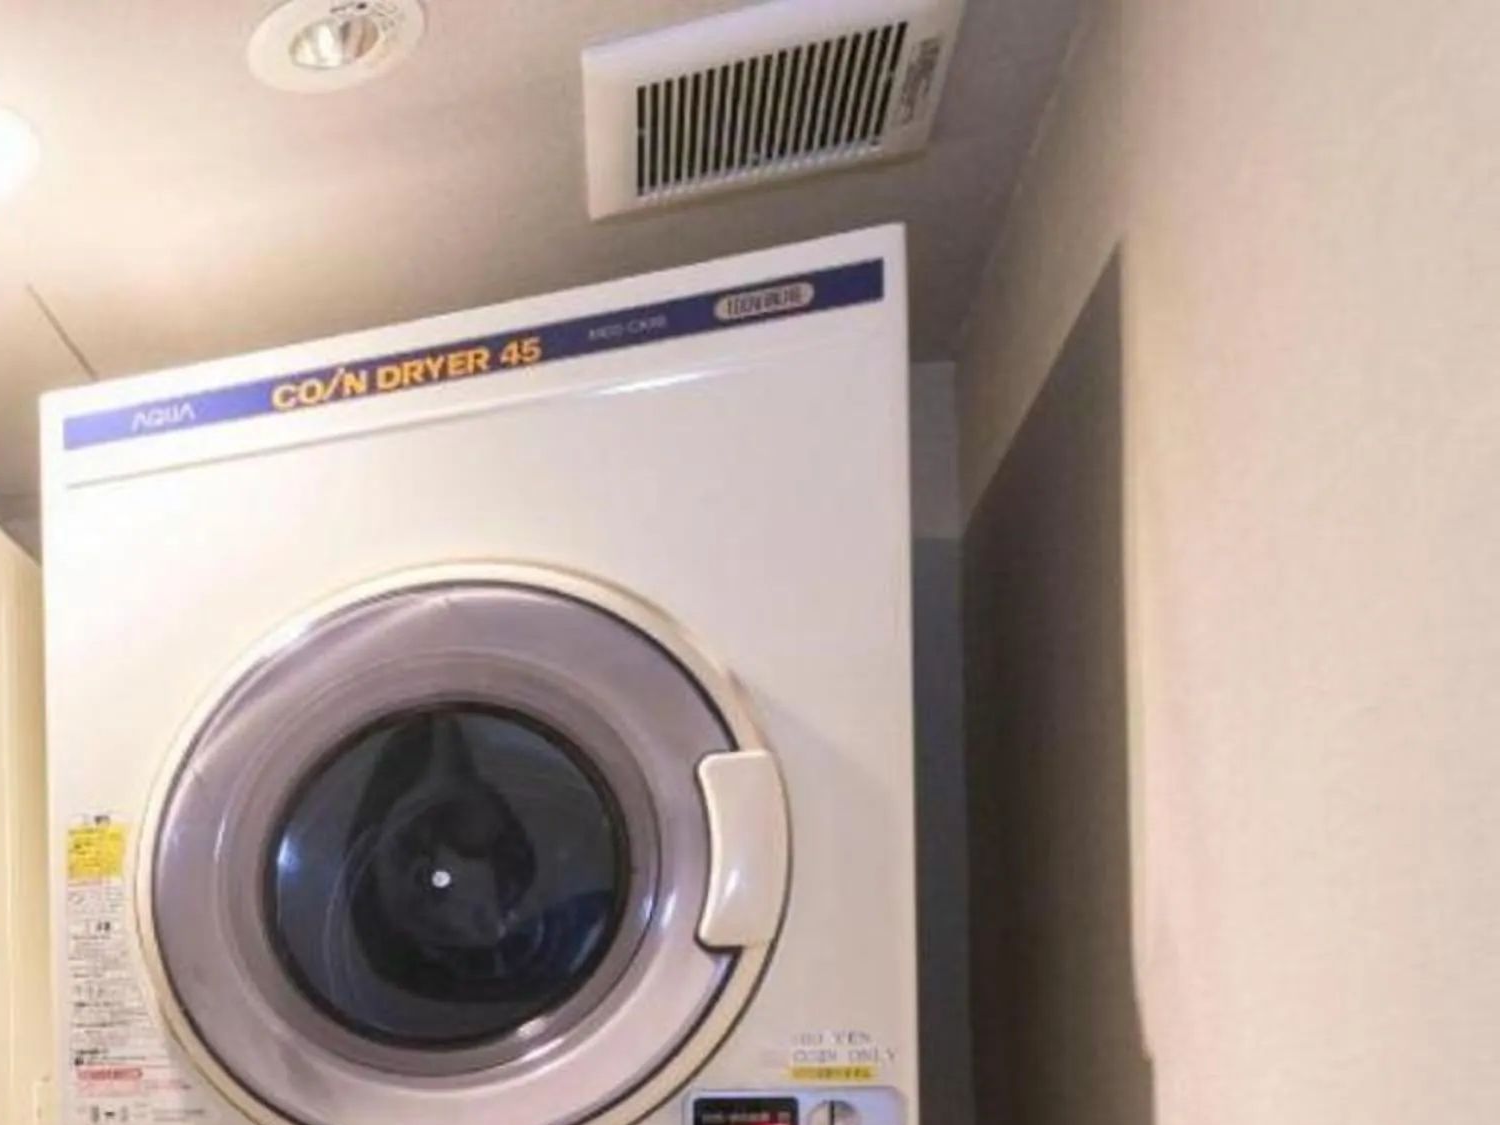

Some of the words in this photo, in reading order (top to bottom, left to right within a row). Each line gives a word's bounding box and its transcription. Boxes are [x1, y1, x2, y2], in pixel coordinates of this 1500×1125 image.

[131, 402, 196, 431] AQUA
[376, 348, 491, 392] DRYER
[500, 336, 542, 367] 45
